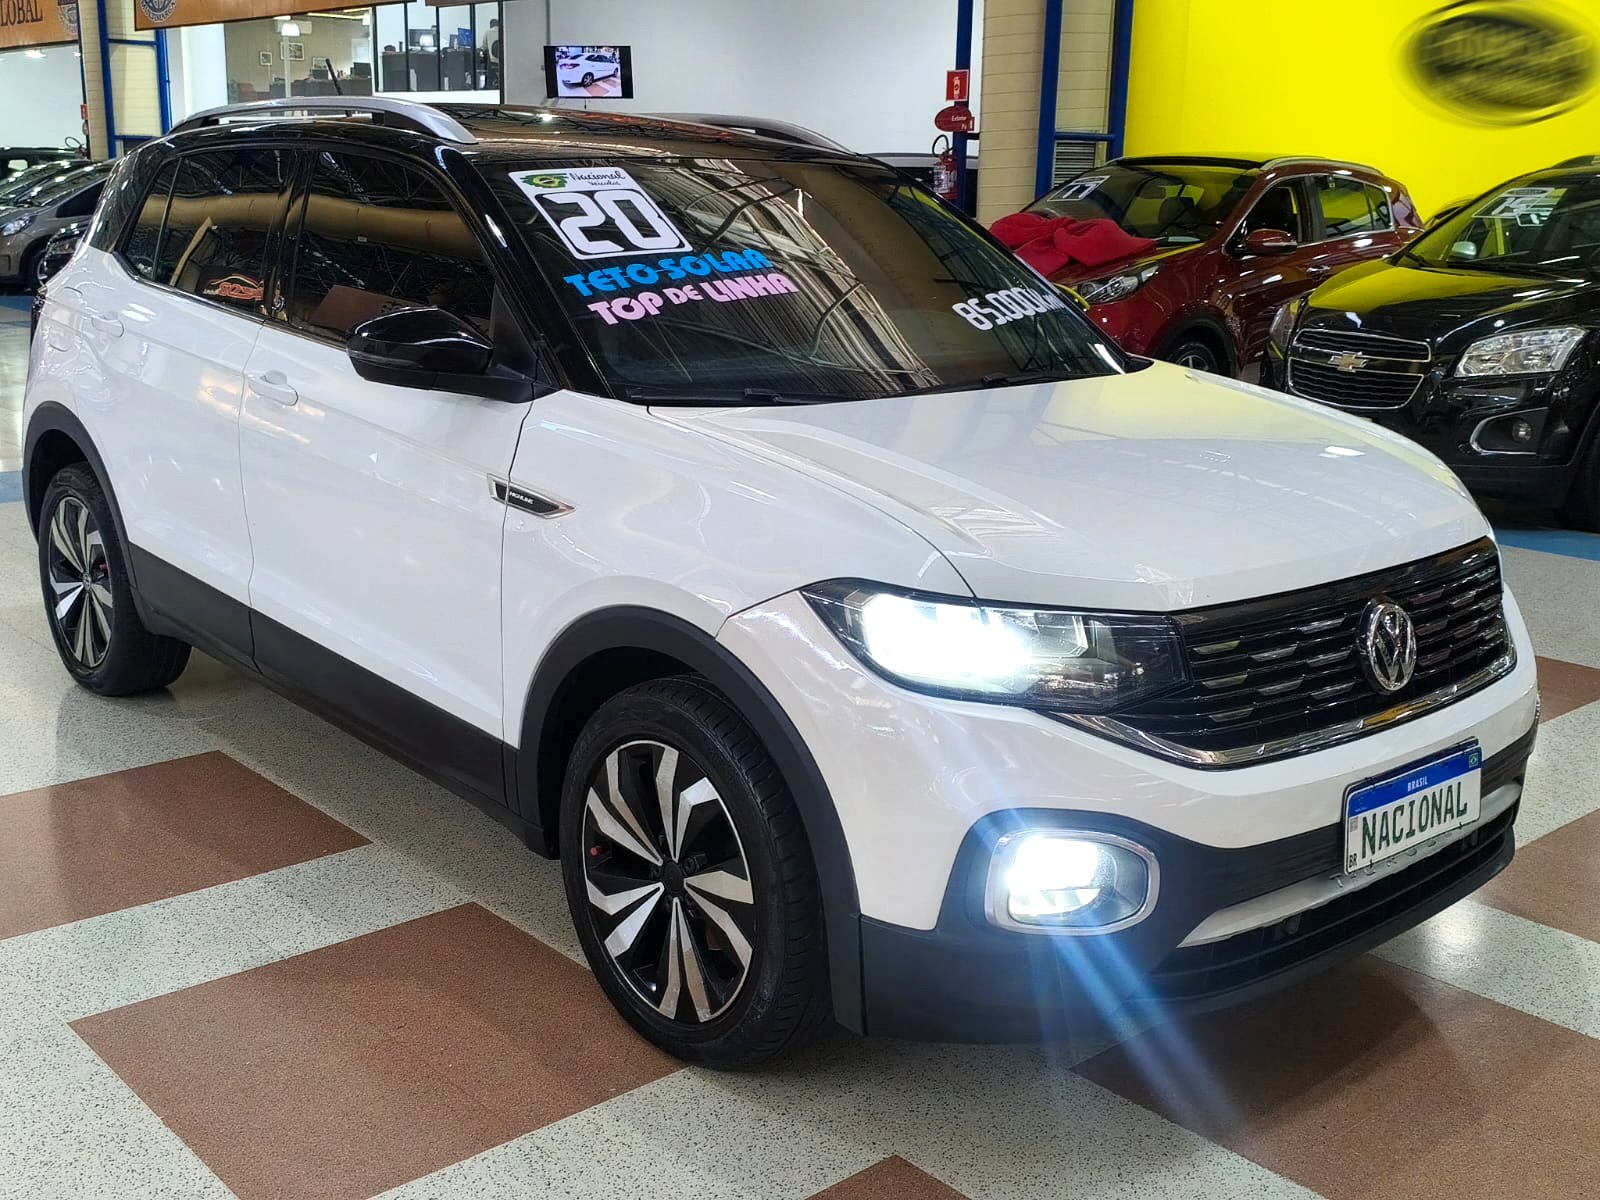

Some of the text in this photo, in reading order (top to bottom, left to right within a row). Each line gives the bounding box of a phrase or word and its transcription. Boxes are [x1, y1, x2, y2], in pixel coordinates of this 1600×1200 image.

[569, 170, 626, 181] Nacional
[541, 189, 680, 254] 20
[563, 248, 774, 297] TETO SOLAR
[587, 272, 800, 325] TOP DE LINHA
[1407, 775, 1429, 793] BRASIL
[1361, 781, 1468, 860] NACIONAL
[1348, 853, 1358, 868] BR
